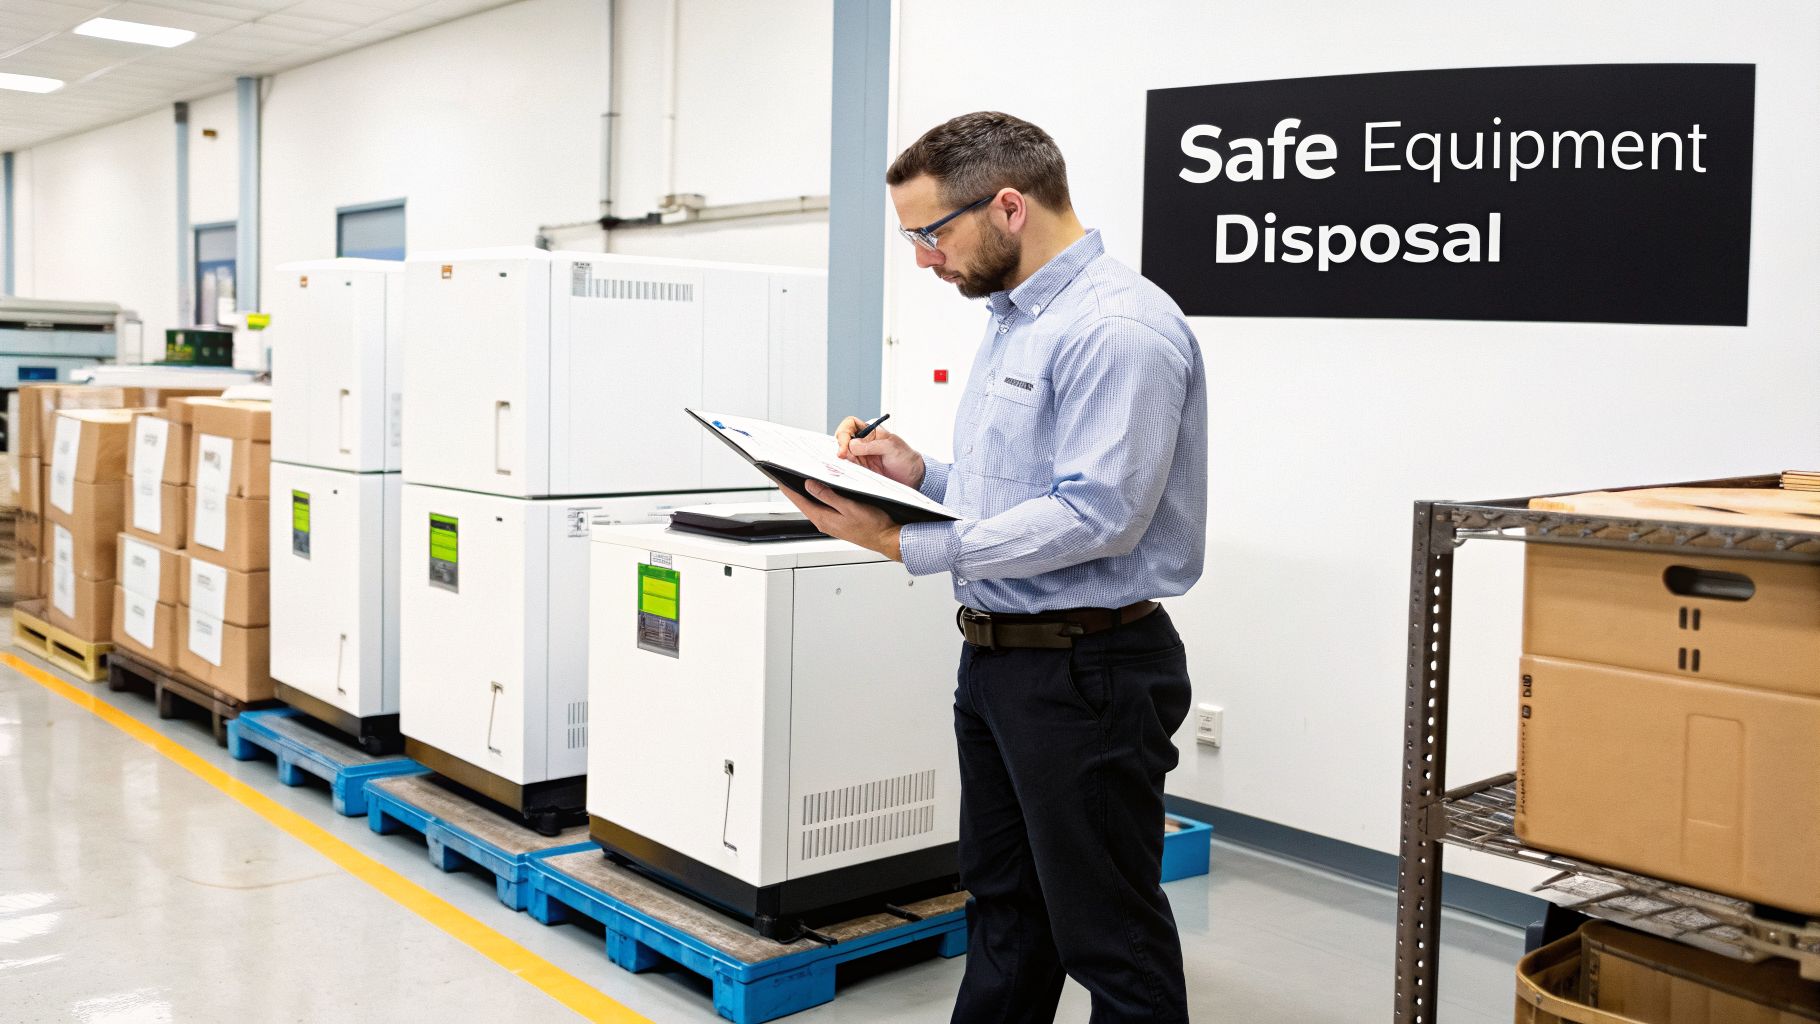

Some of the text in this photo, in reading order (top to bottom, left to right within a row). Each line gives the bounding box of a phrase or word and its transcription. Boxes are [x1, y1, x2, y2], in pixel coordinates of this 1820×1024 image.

[1178, 116, 1708, 184] Safe Equipment
[1215, 211, 1501, 272] Disposal
